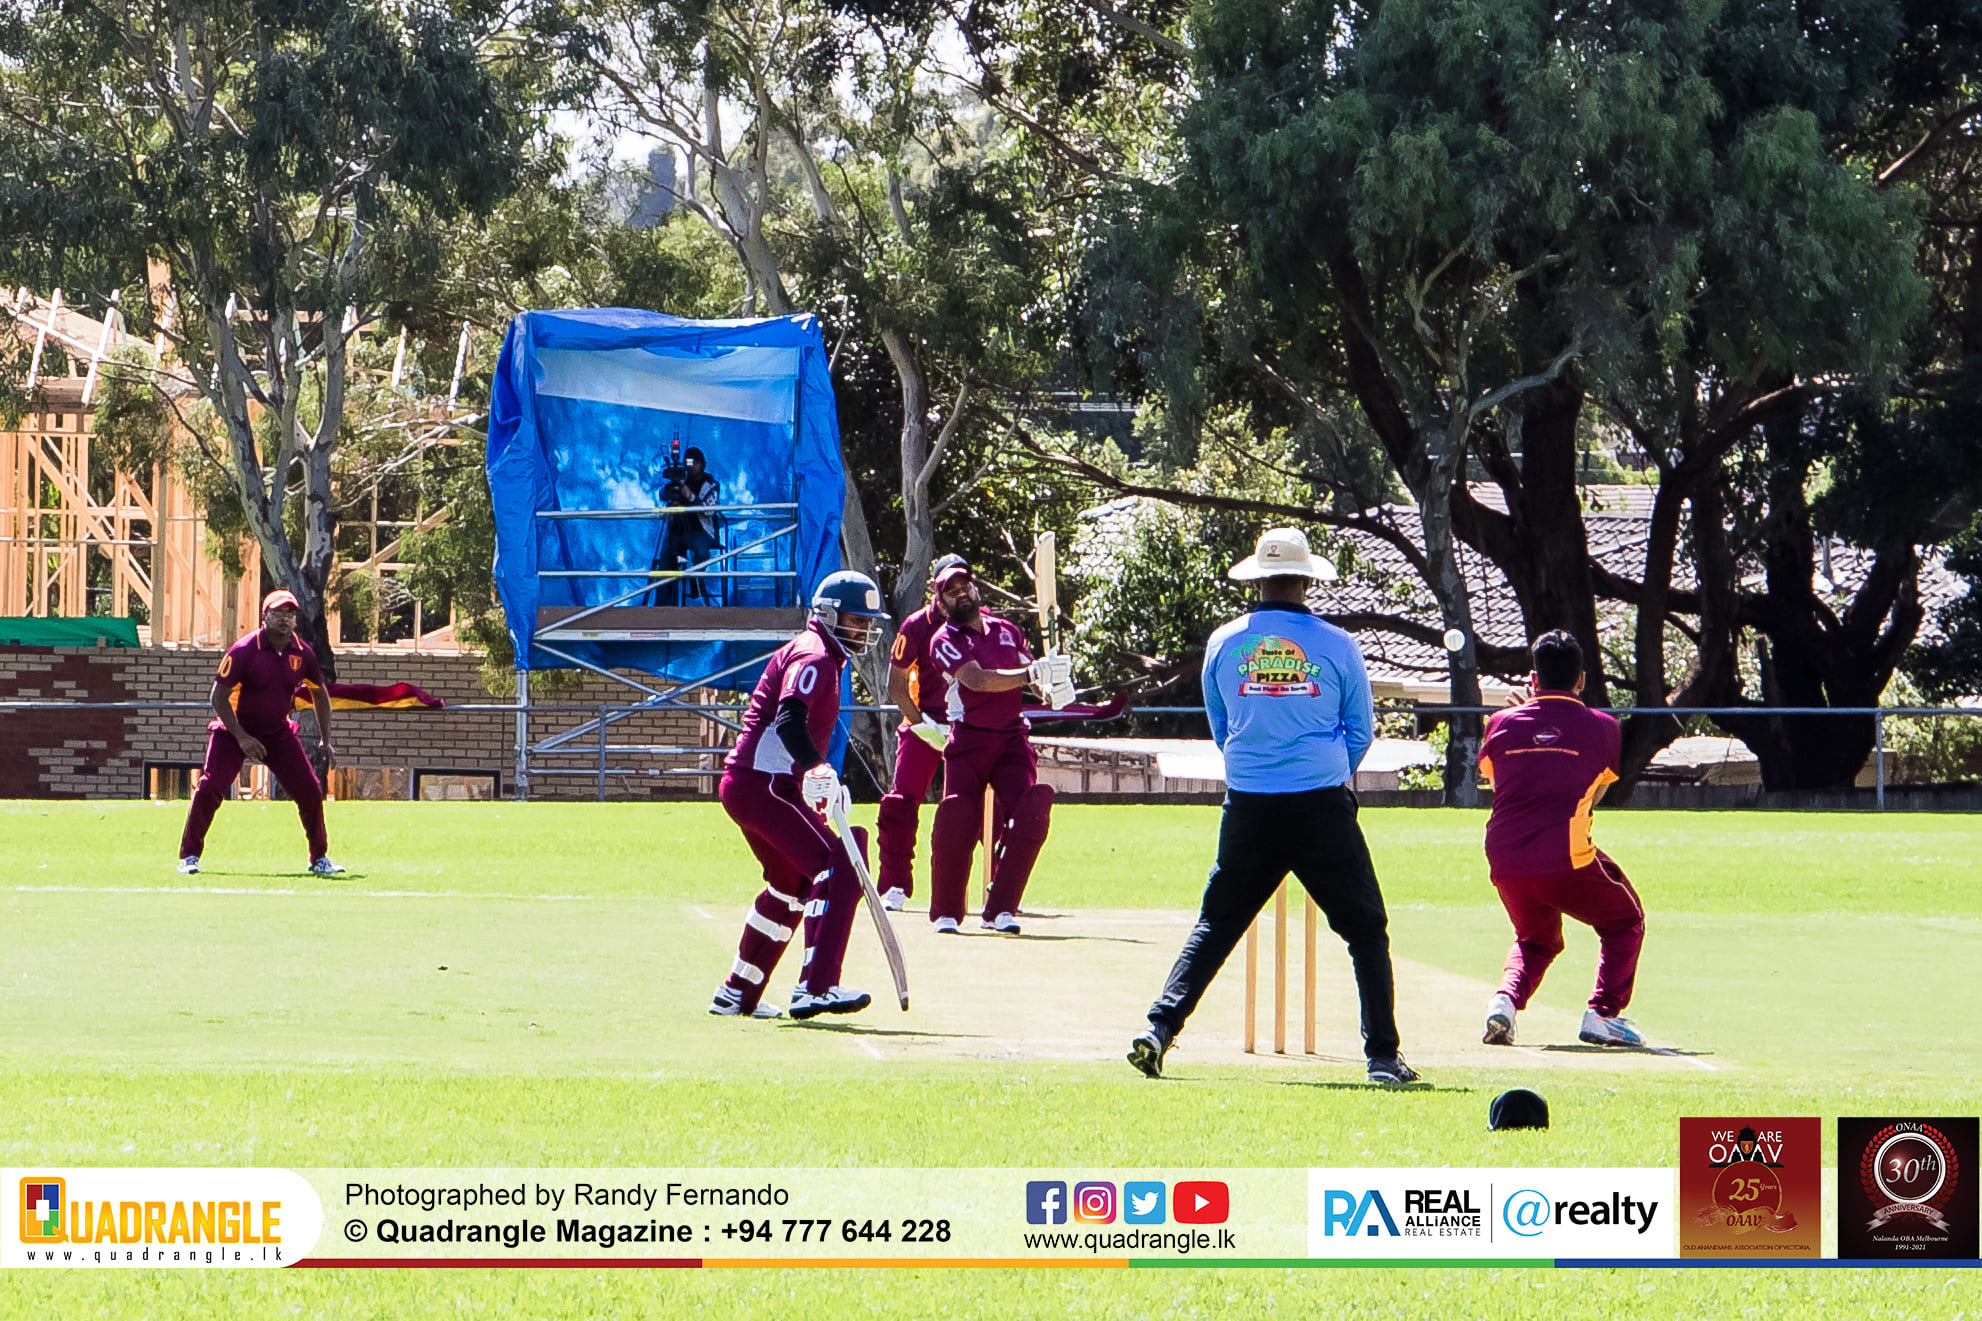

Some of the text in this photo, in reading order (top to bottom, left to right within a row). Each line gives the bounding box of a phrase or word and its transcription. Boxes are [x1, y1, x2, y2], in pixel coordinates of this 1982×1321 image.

[934, 642, 962, 668] 10
[1237, 656, 1322, 678] PARADISE
[786, 662, 818, 695] 10
[1256, 673, 1301, 684] PIZZA
